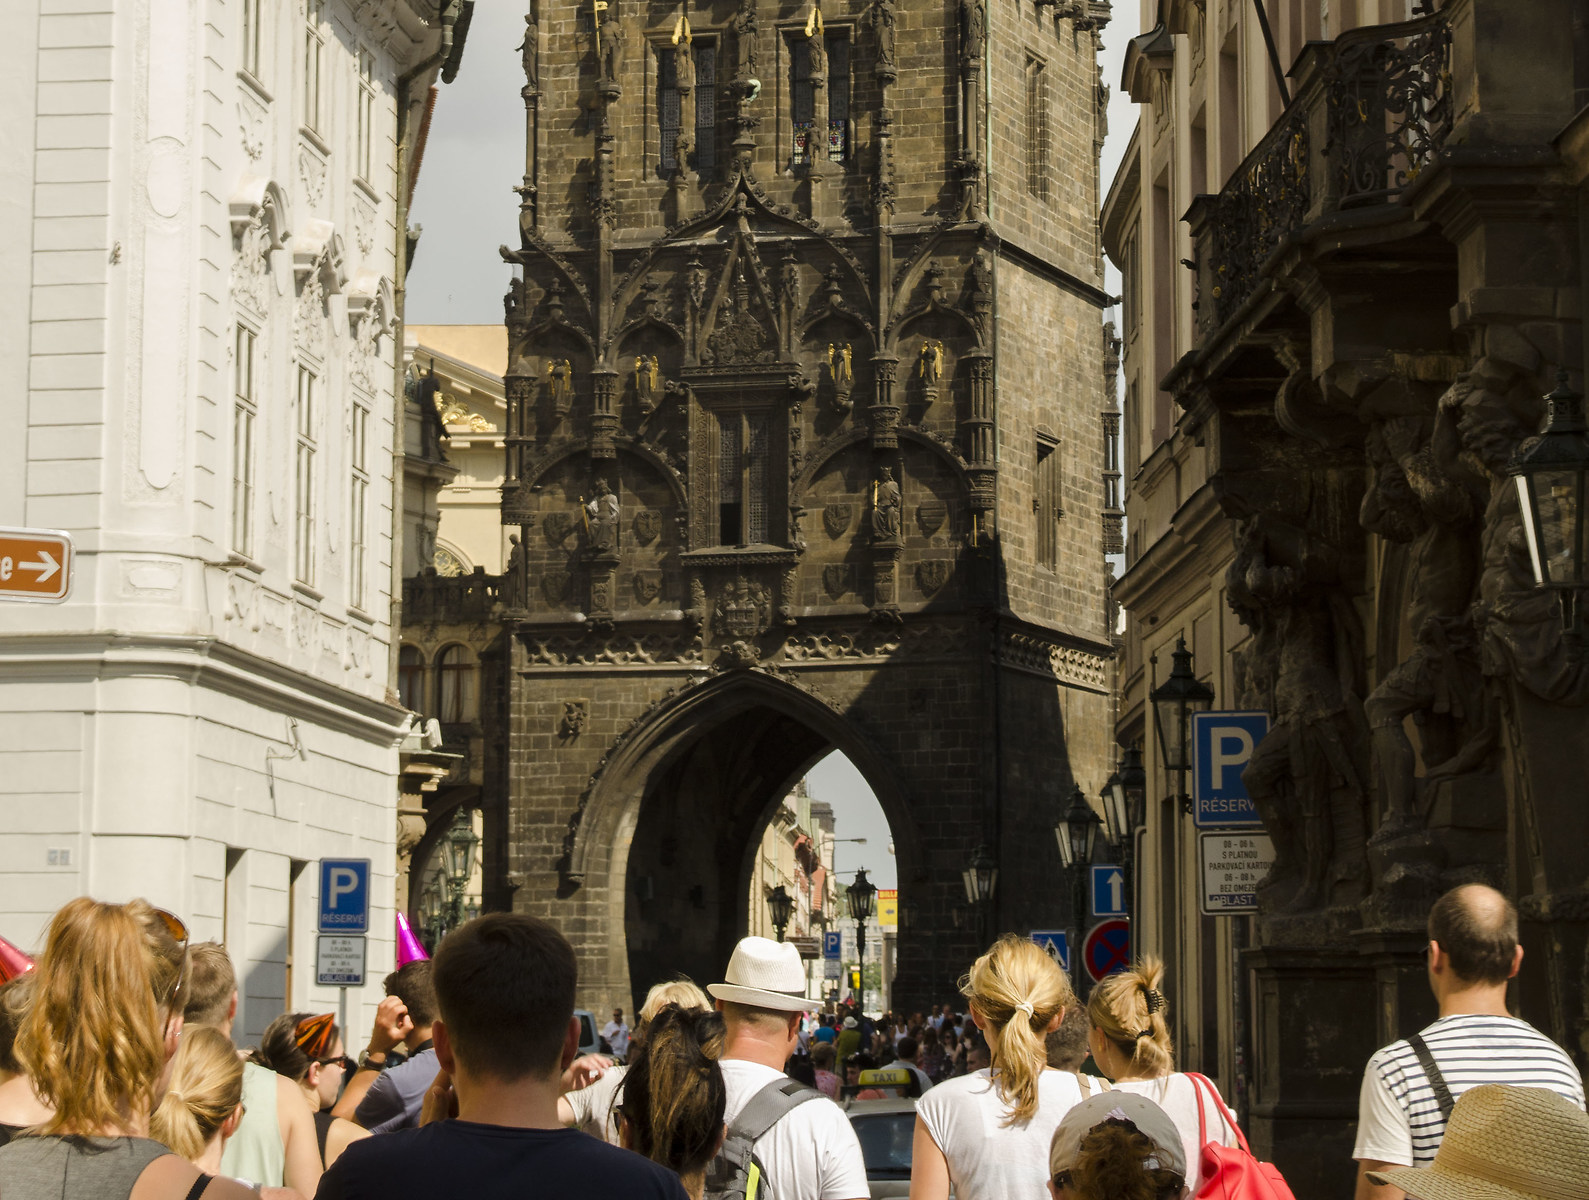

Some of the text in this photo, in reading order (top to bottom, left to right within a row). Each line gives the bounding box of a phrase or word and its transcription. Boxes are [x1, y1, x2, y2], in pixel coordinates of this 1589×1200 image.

[1210, 726, 1254, 790] P
[1200, 796, 1256, 812] RÉSERV
[1222, 850, 1258, 859] S PLATNOU
[329, 868, 359, 908] P
[1234, 884, 1256, 892] OMEZE
[828, 935, 838, 951] P
[872, 1073, 896, 1082] TAXI
